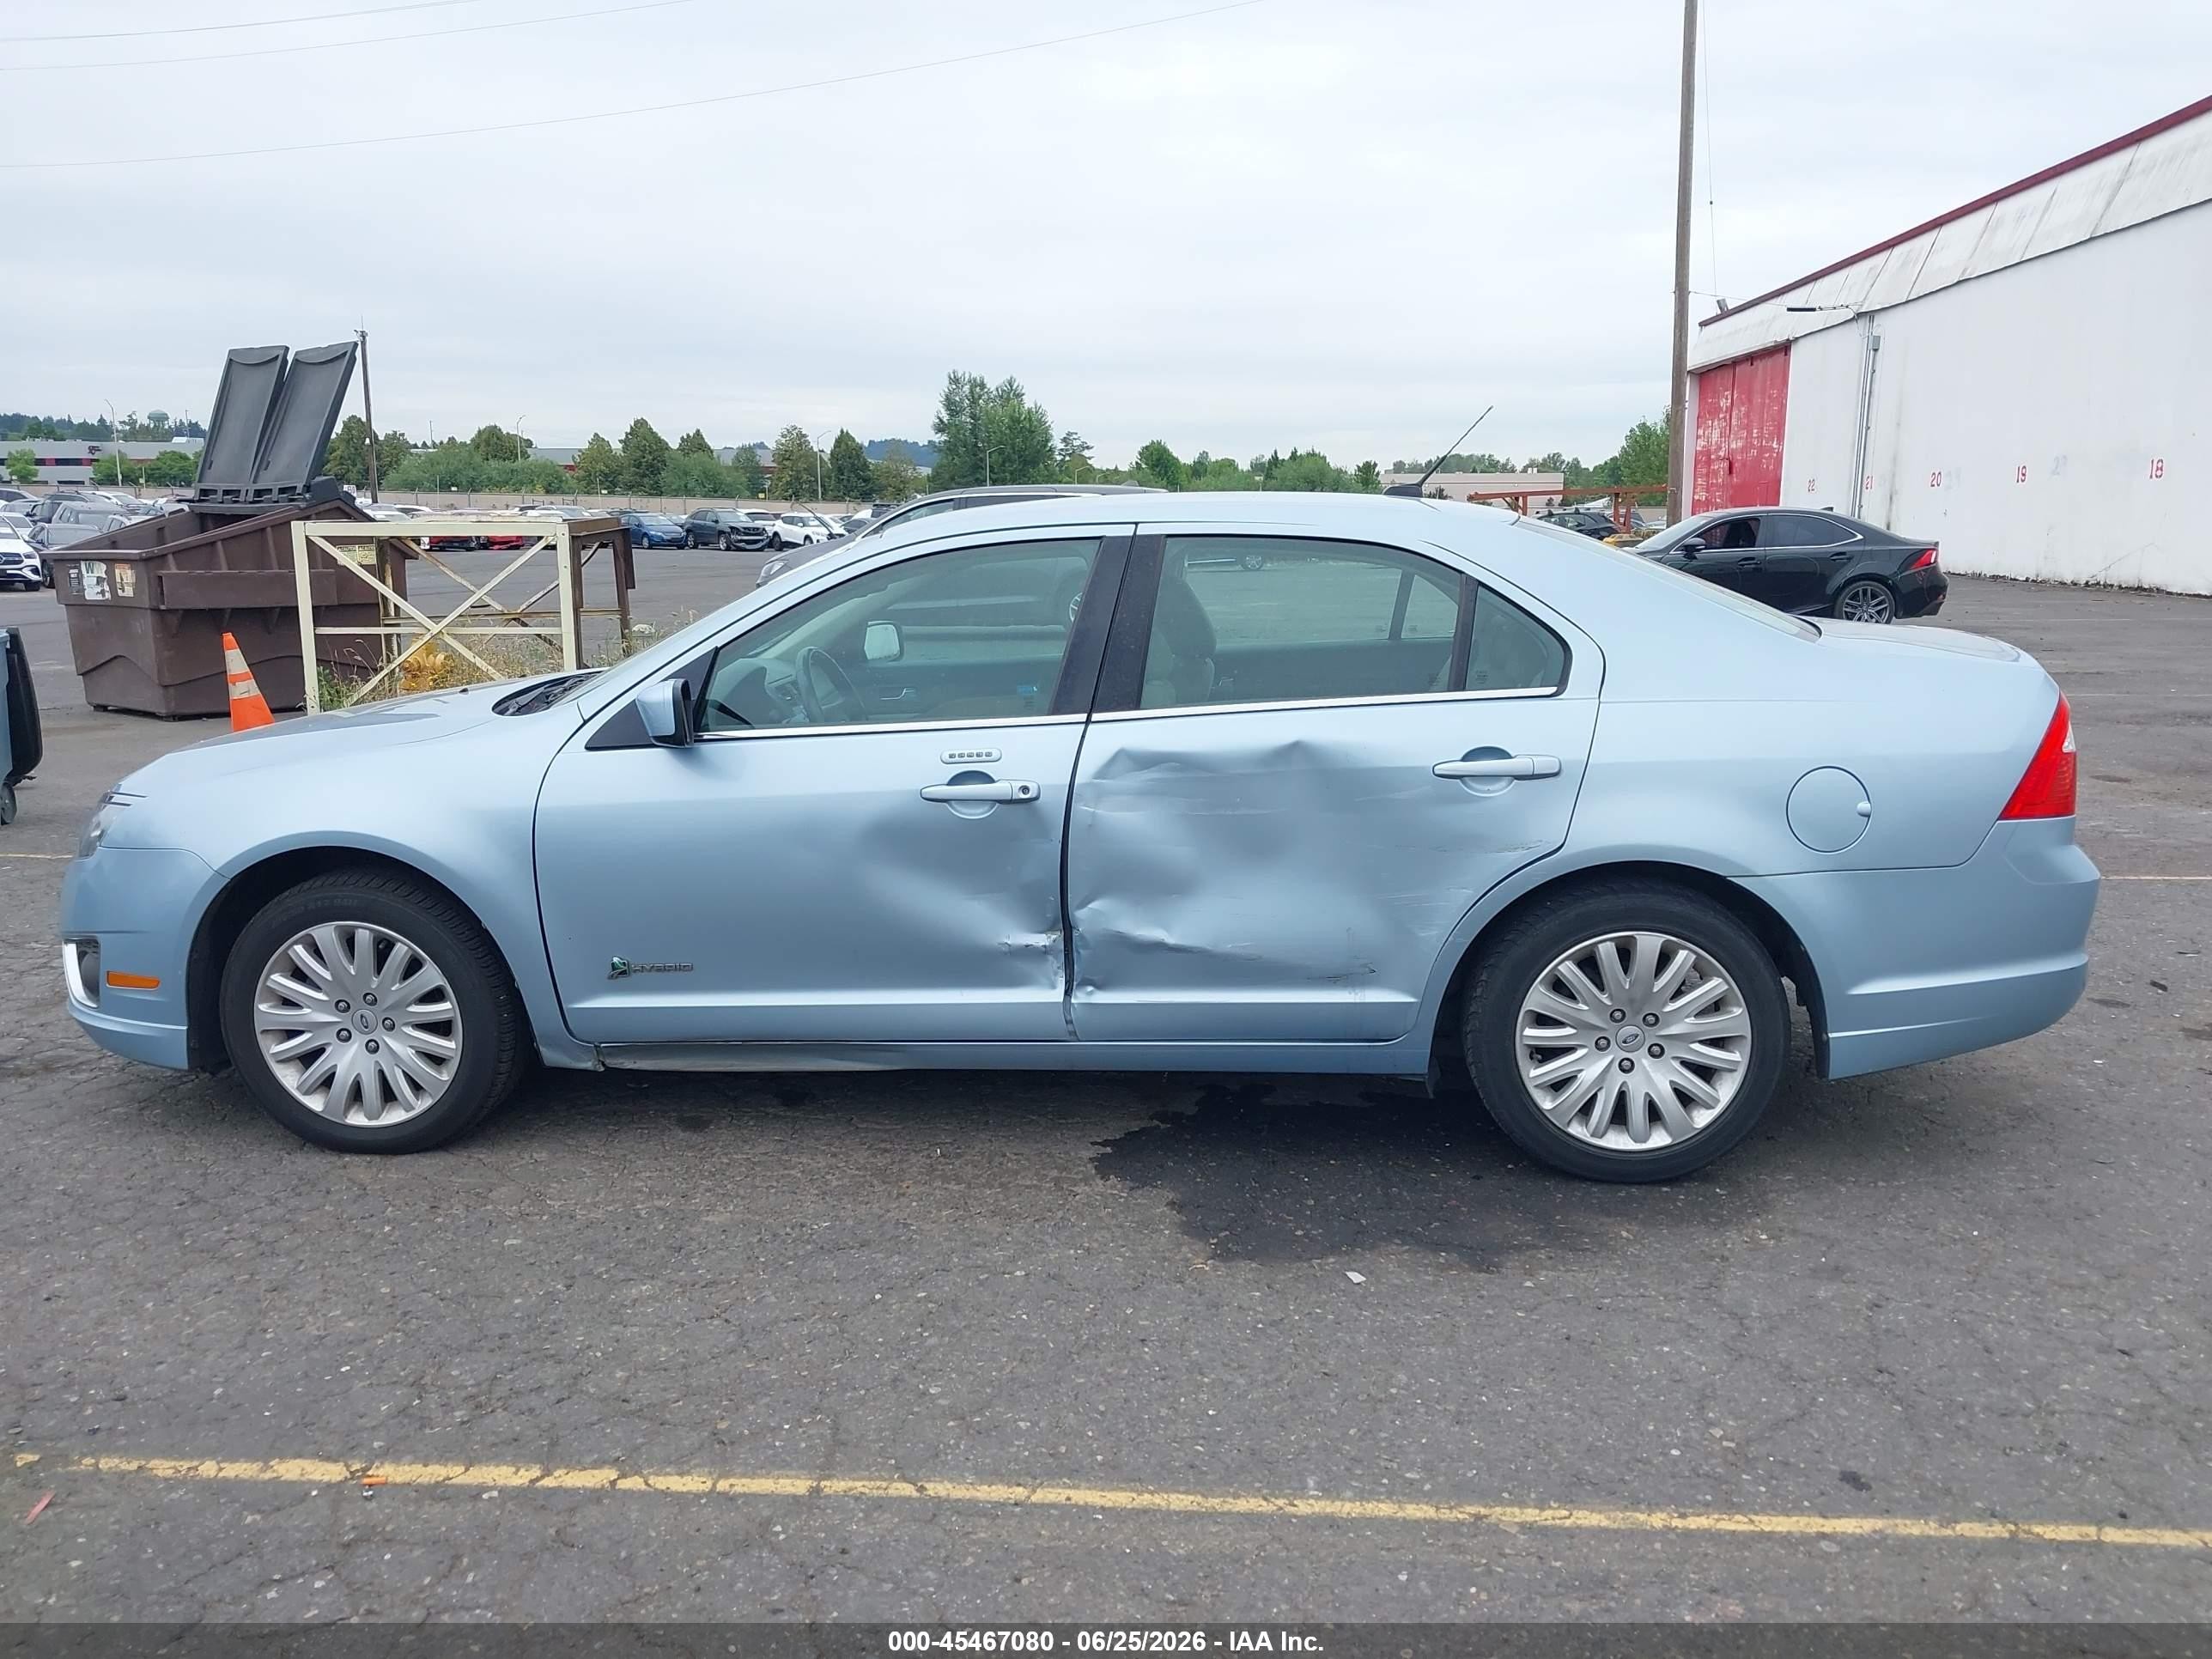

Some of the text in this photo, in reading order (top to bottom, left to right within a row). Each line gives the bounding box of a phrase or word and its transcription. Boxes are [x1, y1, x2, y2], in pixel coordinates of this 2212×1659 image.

[2016, 465, 2027, 483] 19
[2149, 459, 2164, 479] 18
[1808, 478, 1815, 492] 22
[1865, 476, 1874, 490] 21
[1930, 471, 1942, 488] 20
[631, 963, 693, 974] HYBRID
